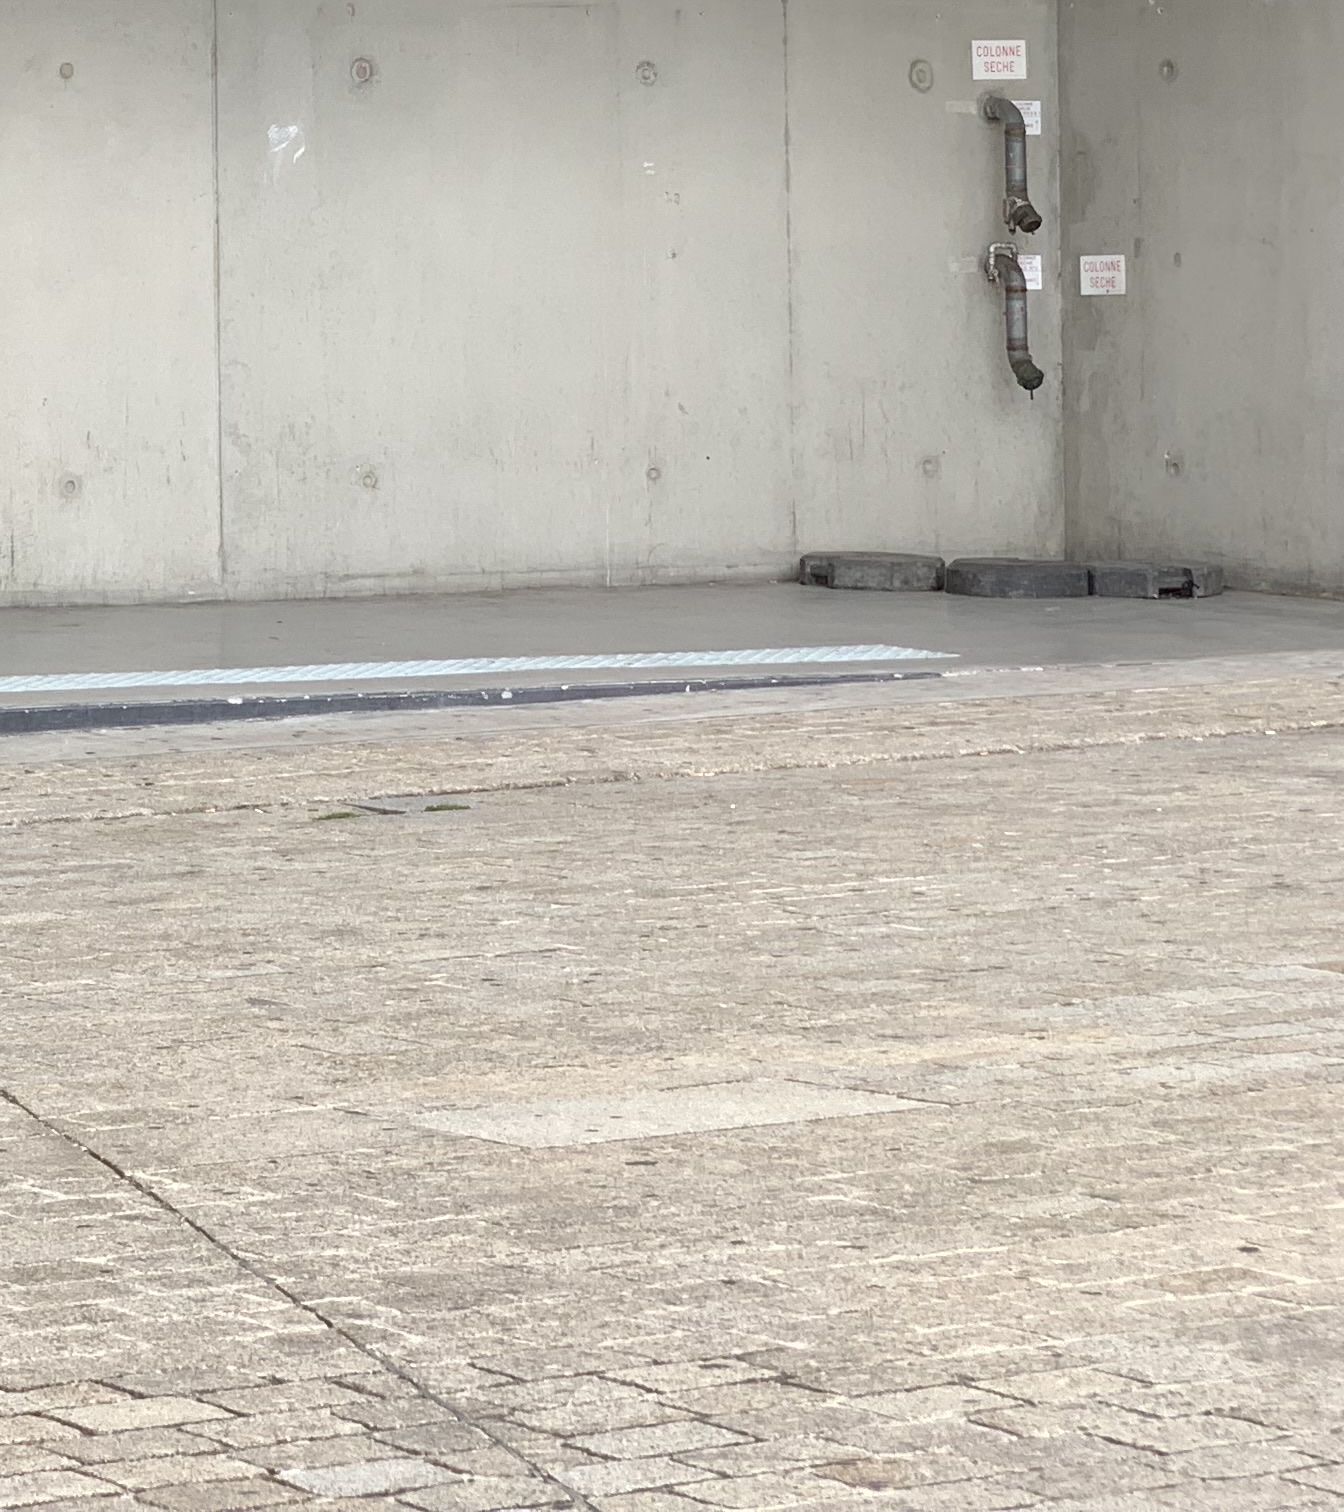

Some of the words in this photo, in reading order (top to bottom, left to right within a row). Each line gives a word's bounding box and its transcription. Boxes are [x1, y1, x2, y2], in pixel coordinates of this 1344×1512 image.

[976, 45, 1021, 57] COLONNE
[983, 61, 1015, 73] SECHE
[1083, 260, 1122, 273] COLONNE
[1089, 276, 1116, 289] SECHE
